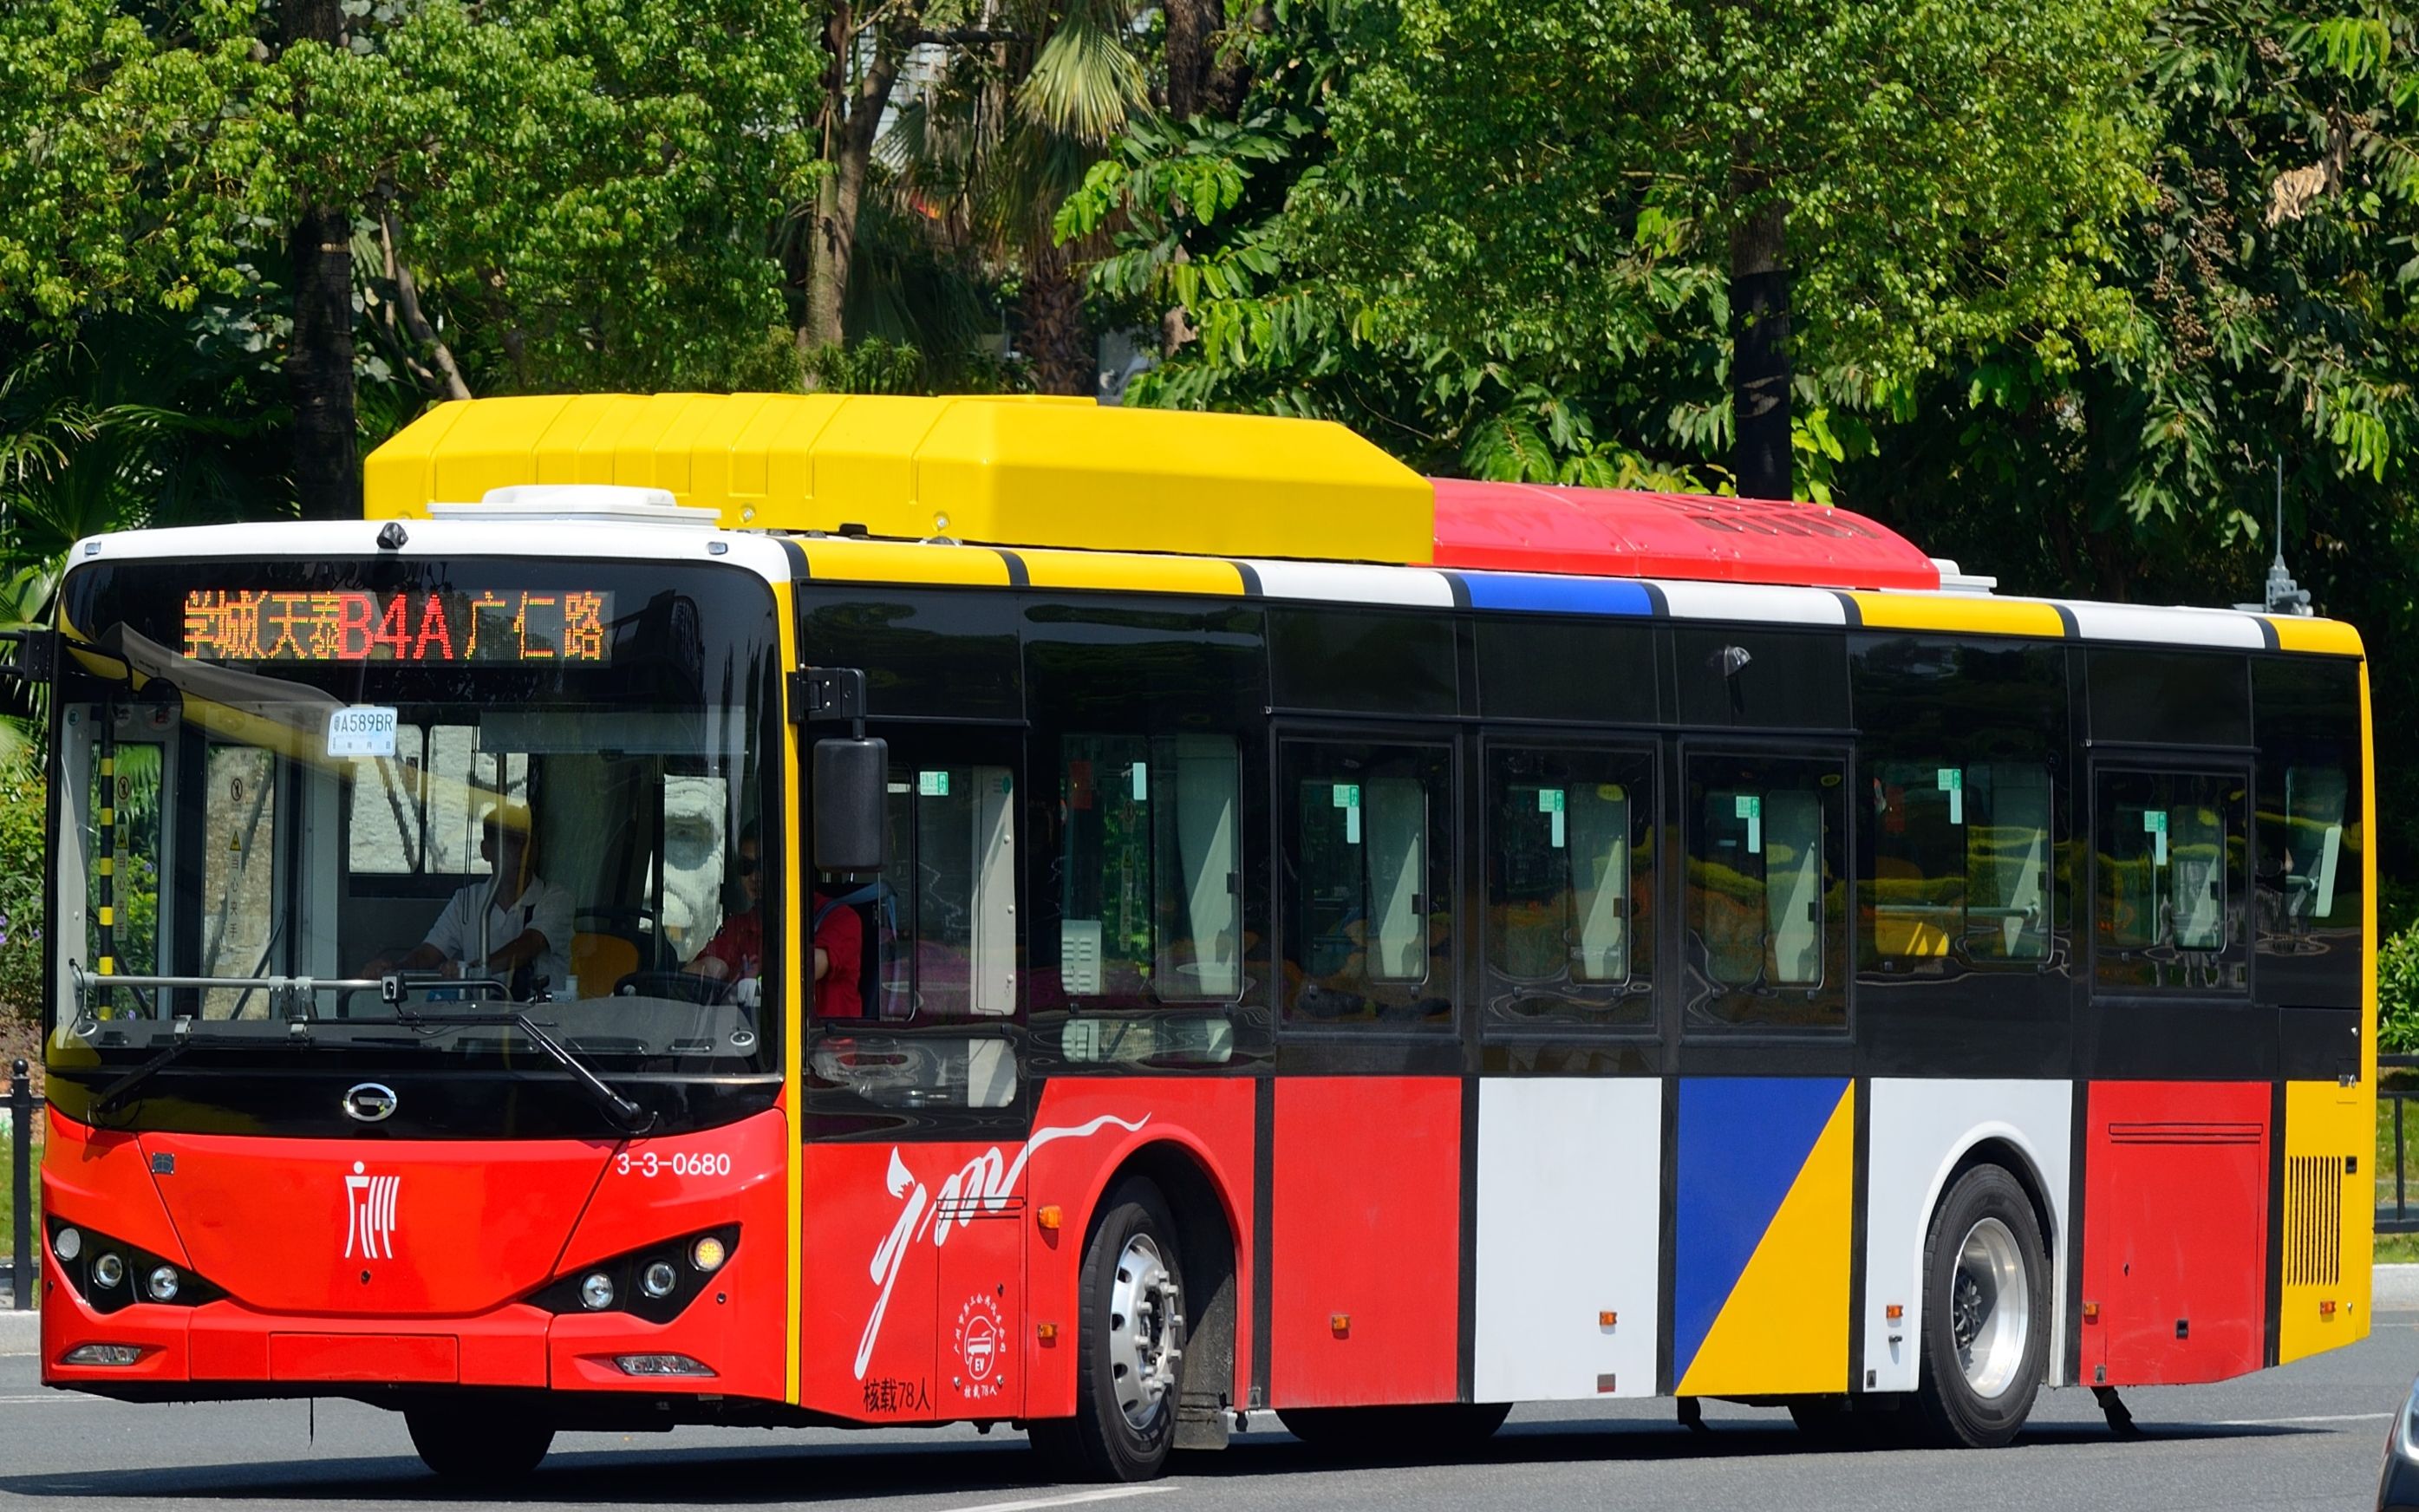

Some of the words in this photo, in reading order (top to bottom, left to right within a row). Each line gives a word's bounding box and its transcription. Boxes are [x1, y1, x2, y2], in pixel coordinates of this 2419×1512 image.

[338, 595, 453, 659] B4A
[465, 590, 603, 660] 广仁路
[617, 1152, 731, 1177] 3-3-0680
[975, 1358, 985, 1372] EV
[864, 1378, 930, 1413] 核载78人
